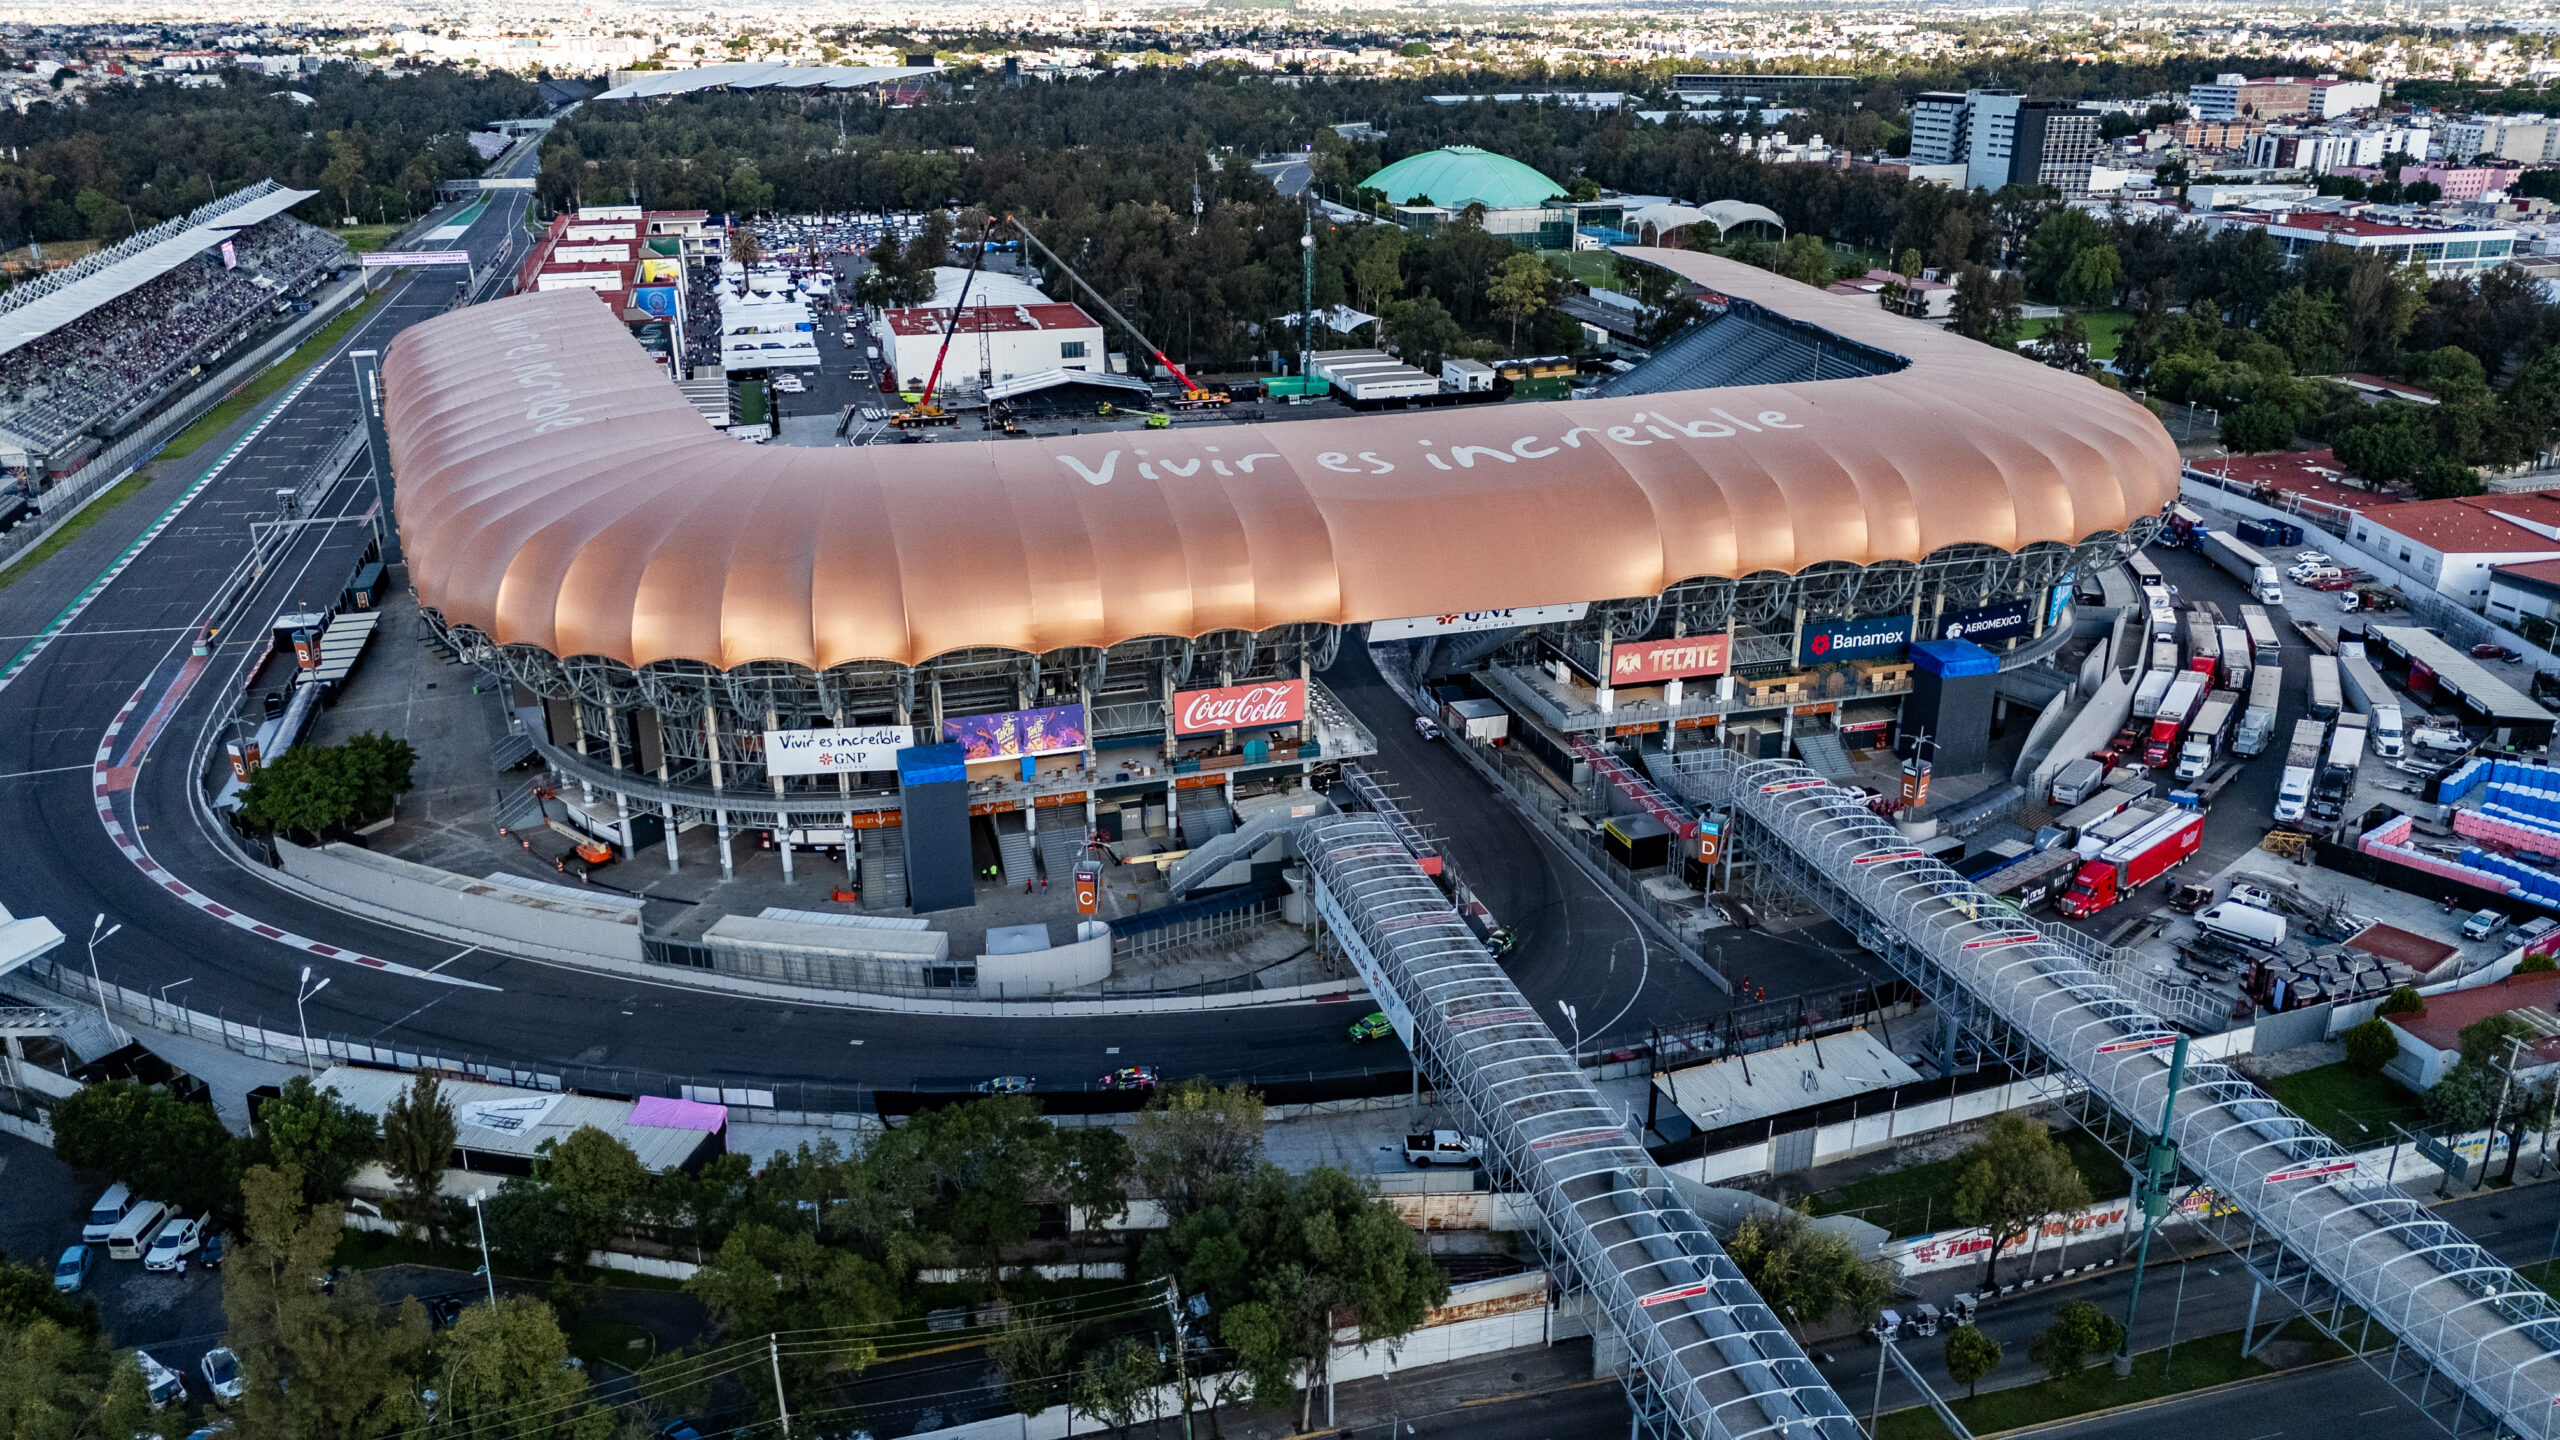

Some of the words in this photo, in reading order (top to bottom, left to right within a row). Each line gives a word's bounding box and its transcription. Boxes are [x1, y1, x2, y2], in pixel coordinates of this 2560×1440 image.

[1056, 446, 1281, 486] Vivir
[1316, 451, 1396, 475] es
[1417, 406, 1805, 471] increíble
[1964, 615, 2022, 634] AEROMEXICO
[1832, 631, 1904, 650] Banamex
[298, 649, 309, 662] B
[1648, 644, 1722, 673] TECATE
[1184, 685, 1293, 729] Coca-Cola
[779, 734, 815, 750] Vivir
[819, 737, 833, 748] es
[837, 730, 902, 748] increíble
[834, 752, 867, 765] GNP
[233, 761, 245, 776] B
[1903, 783, 1914, 799] E
[1918, 784, 1928, 798] E
[1702, 841, 1715, 855] D
[1080, 891, 1094, 906] C
